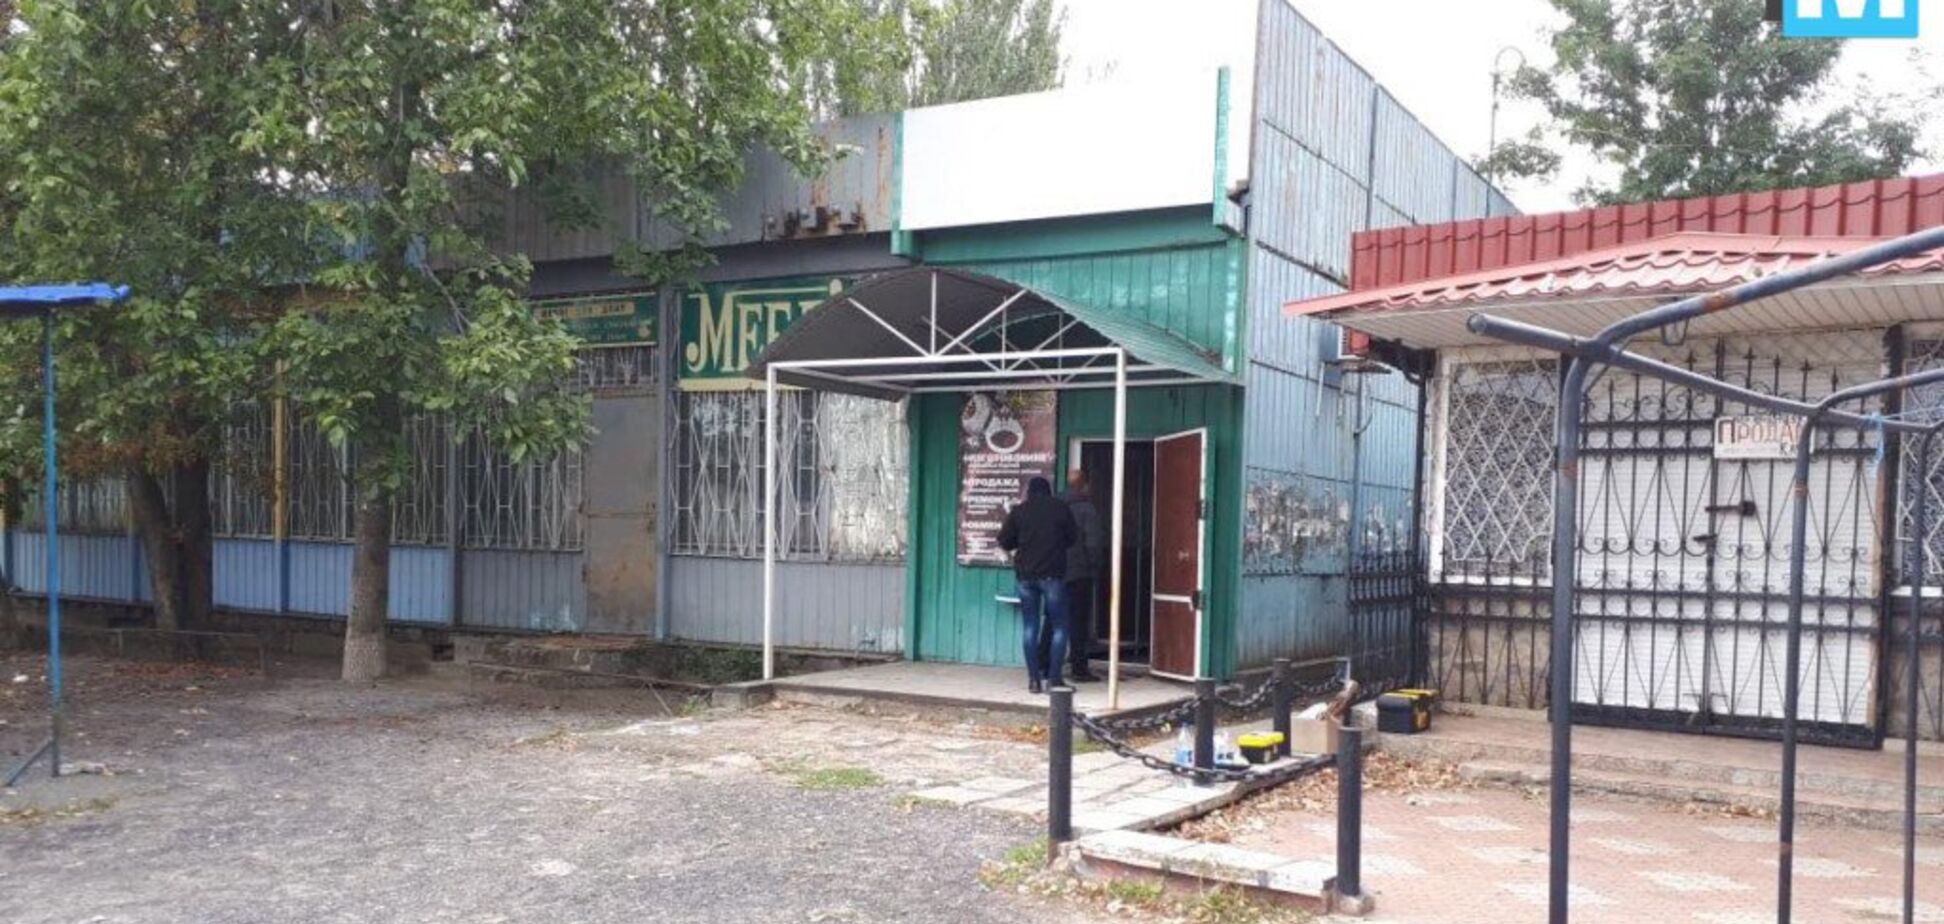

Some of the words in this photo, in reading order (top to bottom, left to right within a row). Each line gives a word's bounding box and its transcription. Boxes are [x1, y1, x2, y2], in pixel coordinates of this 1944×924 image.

[686, 290, 824, 373] МЕБ
[1717, 417, 1799, 444] ПРОДА
[967, 477, 1020, 487] ПРОДАЖА
